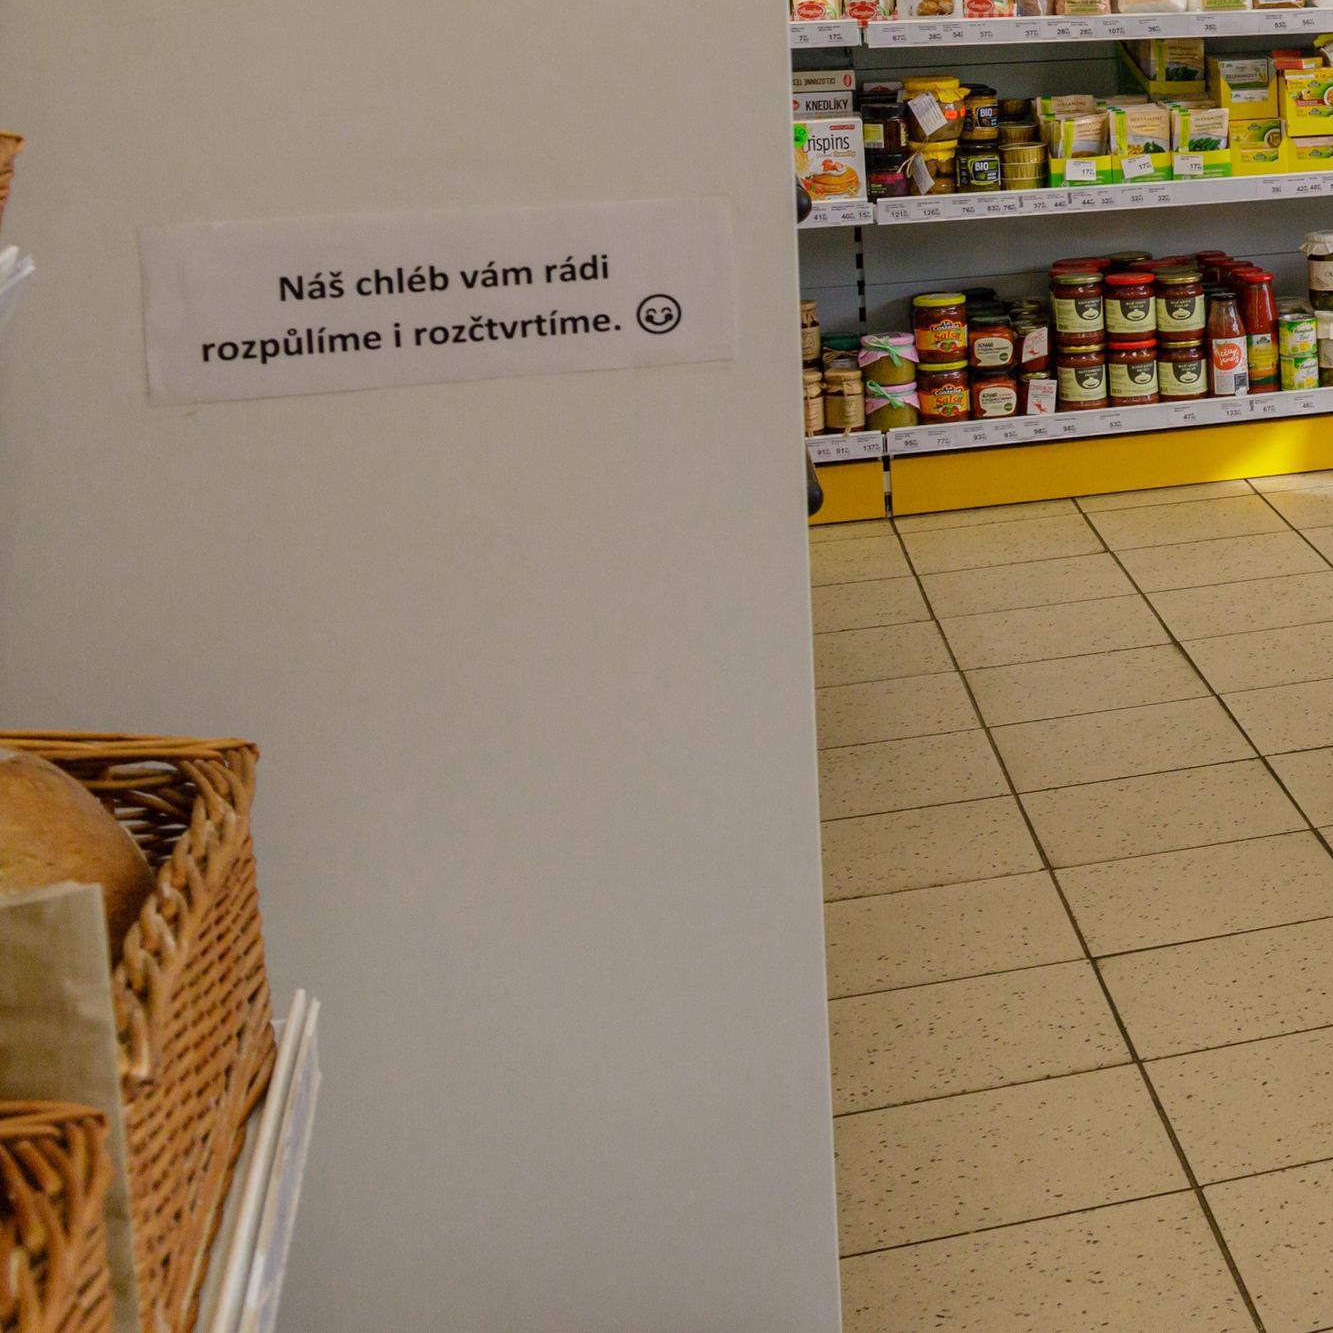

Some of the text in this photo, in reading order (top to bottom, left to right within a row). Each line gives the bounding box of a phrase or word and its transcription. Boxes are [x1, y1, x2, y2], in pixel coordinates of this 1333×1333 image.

[805, 98, 848, 111] KNEDLÍKY
[980, 108, 993, 118] BIO
[975, 161, 989, 171] BIO
[279, 254, 610, 302] Náš chléb vám rádi
[201, 309, 622, 365] rozpůlíme i rozčtvrtíme.
[934, 331, 961, 340] Salsa
[936, 396, 962, 404] Salsa
